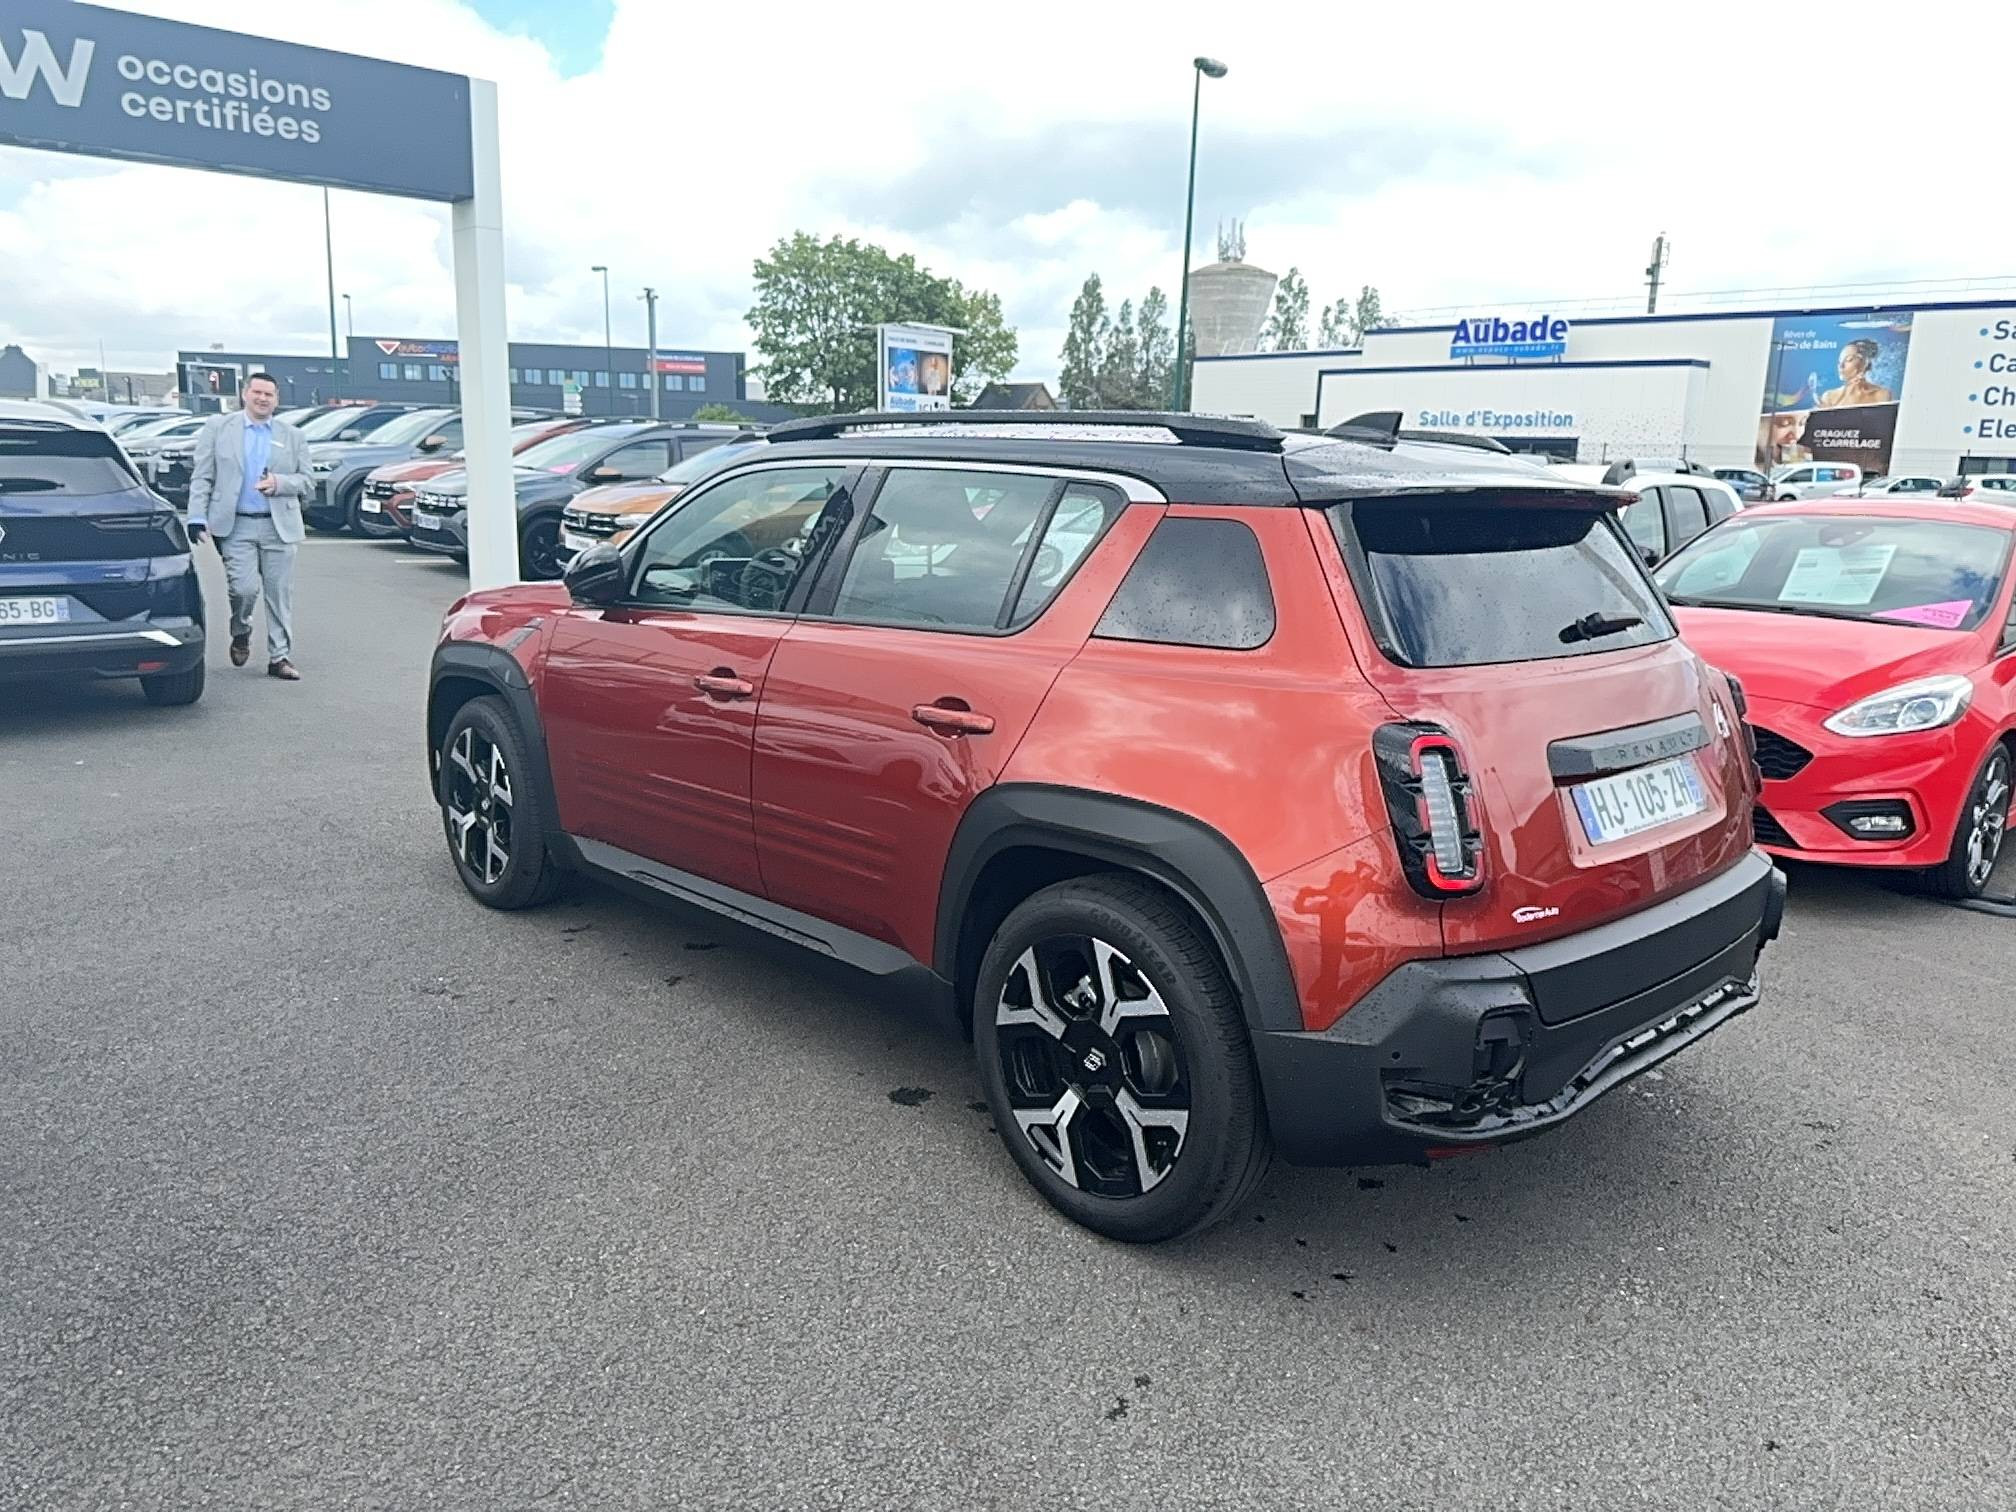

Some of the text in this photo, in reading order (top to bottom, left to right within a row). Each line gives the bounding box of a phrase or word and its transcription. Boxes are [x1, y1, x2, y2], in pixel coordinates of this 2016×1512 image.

[117, 54, 332, 112] occasions
[120, 91, 321, 144] certifiées
[1452, 314, 1569, 345] Aubade
[1813, 339, 1838, 350] Bains
[1983, 386, 2016, 406] Ch
[1419, 410, 1574, 430] Salle d'Exposition
[1978, 418, 2016, 438] Ele
[1822, 439, 1882, 449] CARRELAGE
[1616, 731, 1694, 760] RENAULT
[1590, 765, 1693, 831] HJ-105-ZH
